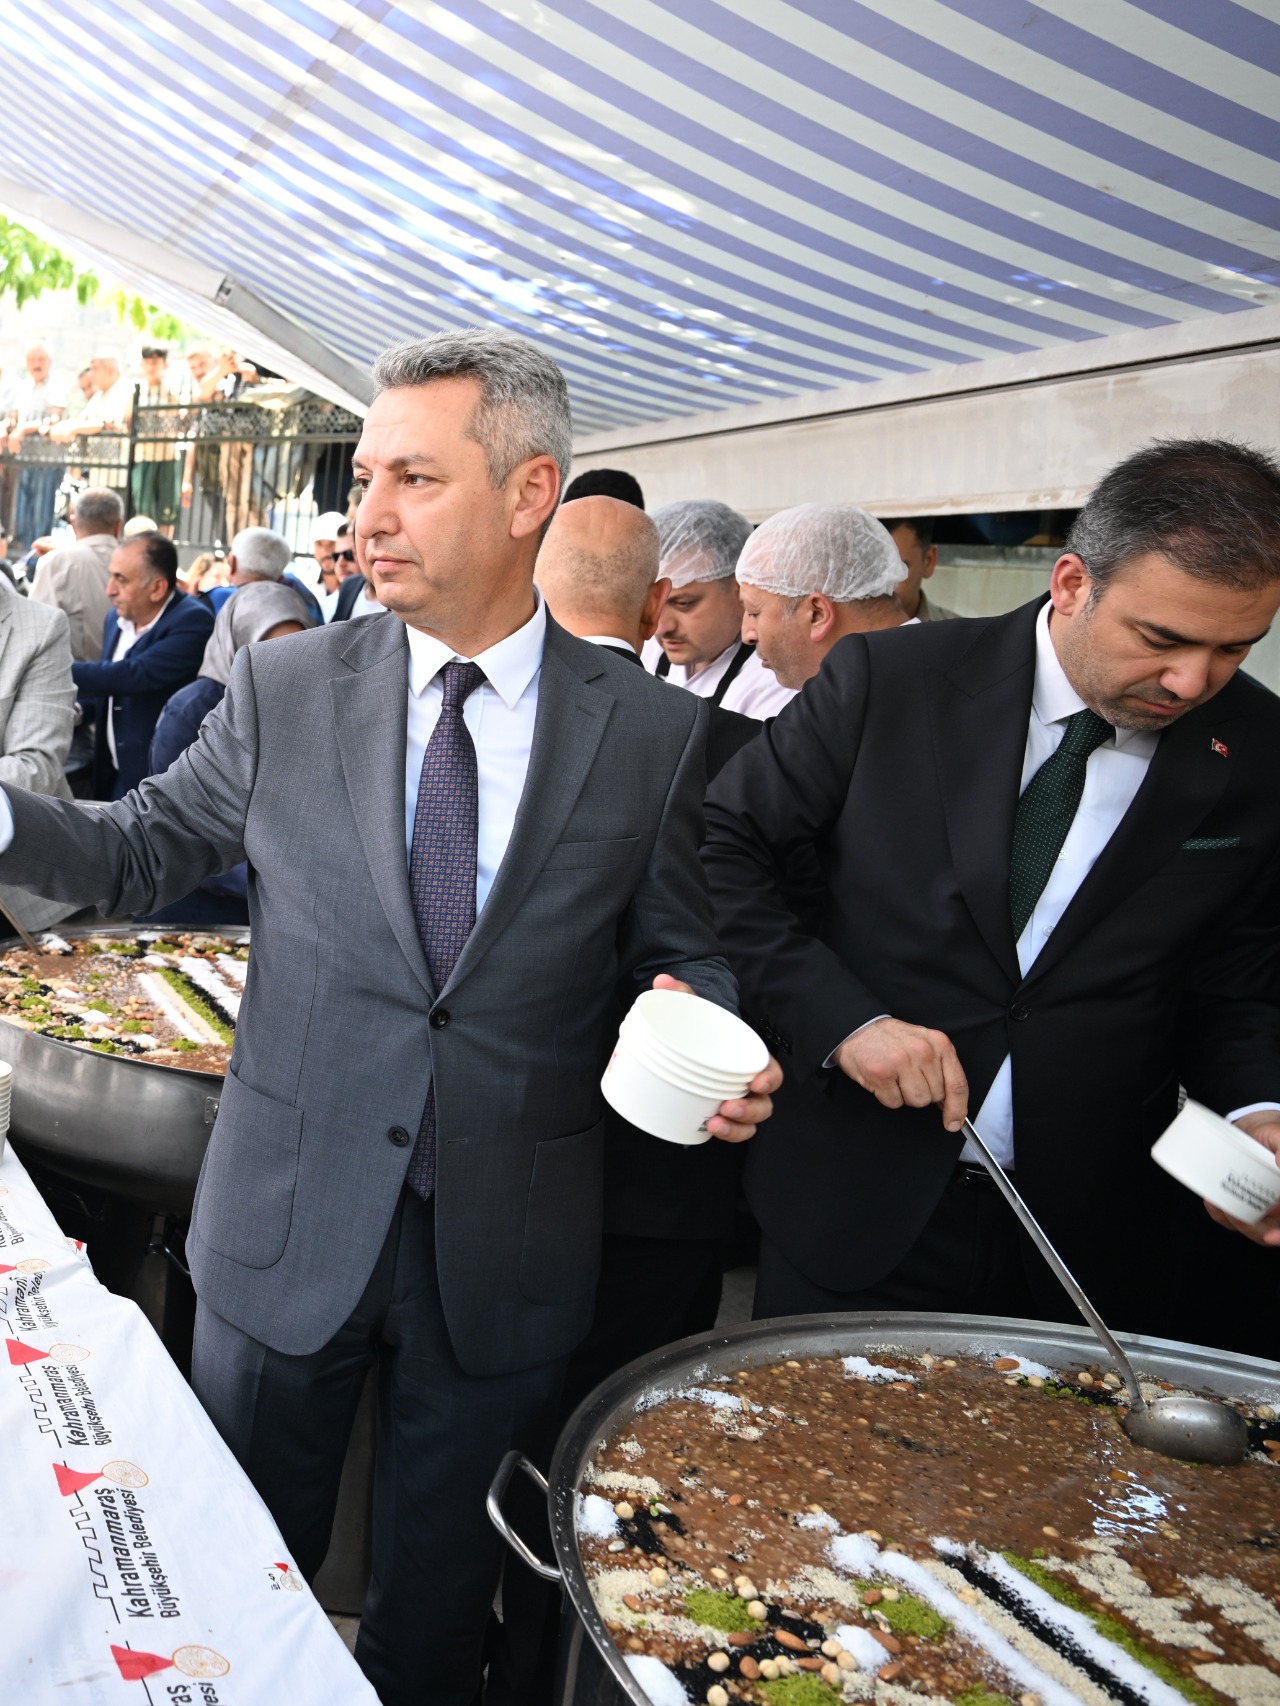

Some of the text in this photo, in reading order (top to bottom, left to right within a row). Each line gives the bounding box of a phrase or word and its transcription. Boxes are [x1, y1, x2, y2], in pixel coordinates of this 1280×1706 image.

[41, 1365, 90, 1446] Kahramanmaraş
[61, 1363, 113, 1446] Büyükşehir Belediyesi
[94, 1486, 154, 1618] Kahramanmaraş
[116, 1487, 181, 1619] Büyükşehir Belediyesi
